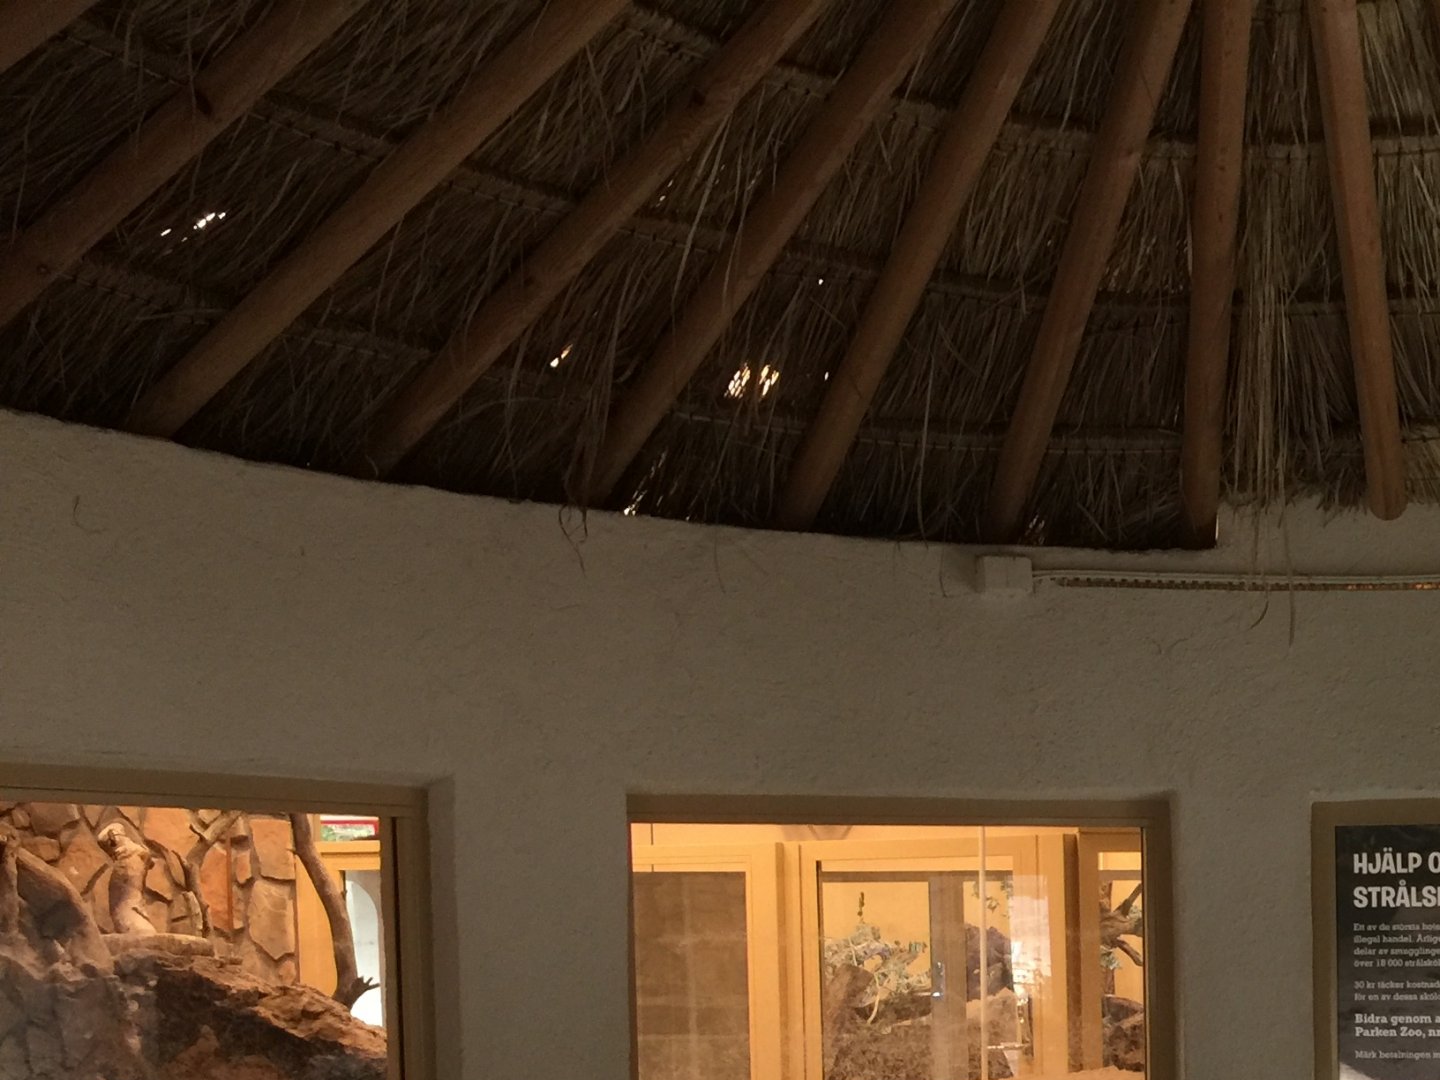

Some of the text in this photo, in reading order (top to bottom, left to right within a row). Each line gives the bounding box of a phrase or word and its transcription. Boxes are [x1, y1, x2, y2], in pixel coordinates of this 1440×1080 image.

[1353, 847, 1422, 875] HJÄLP
[1354, 1013, 1388, 1024] Bidra
[1390, 1015, 1432, 1026] genom
[1354, 1026, 1397, 1037] Parken
[1400, 1026, 1426, 1038] Zoo,
